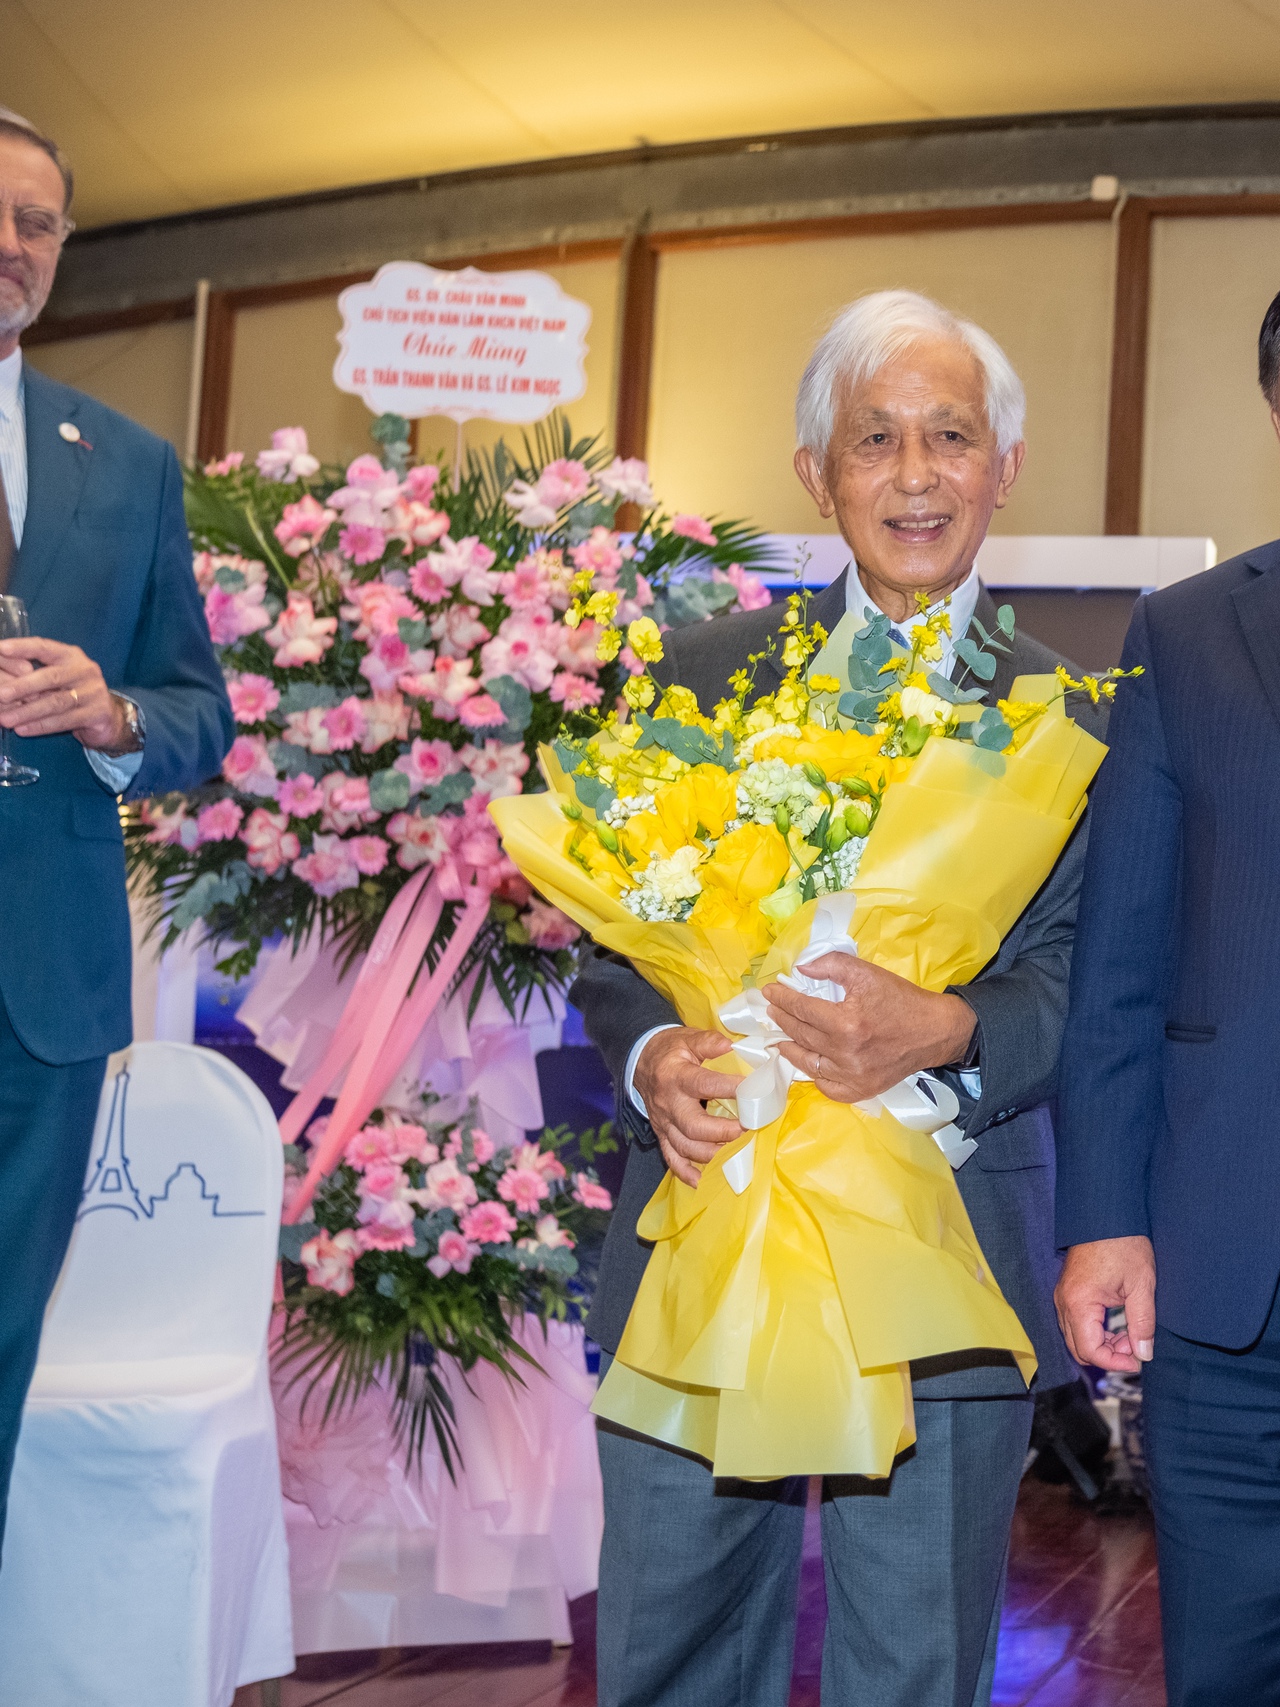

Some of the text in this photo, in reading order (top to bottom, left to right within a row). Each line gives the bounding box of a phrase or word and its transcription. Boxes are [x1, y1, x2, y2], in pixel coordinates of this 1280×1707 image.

[543, 320, 566, 331] NAM
[403, 332, 456, 357] Chúc
[511, 378, 530, 392] KIM
